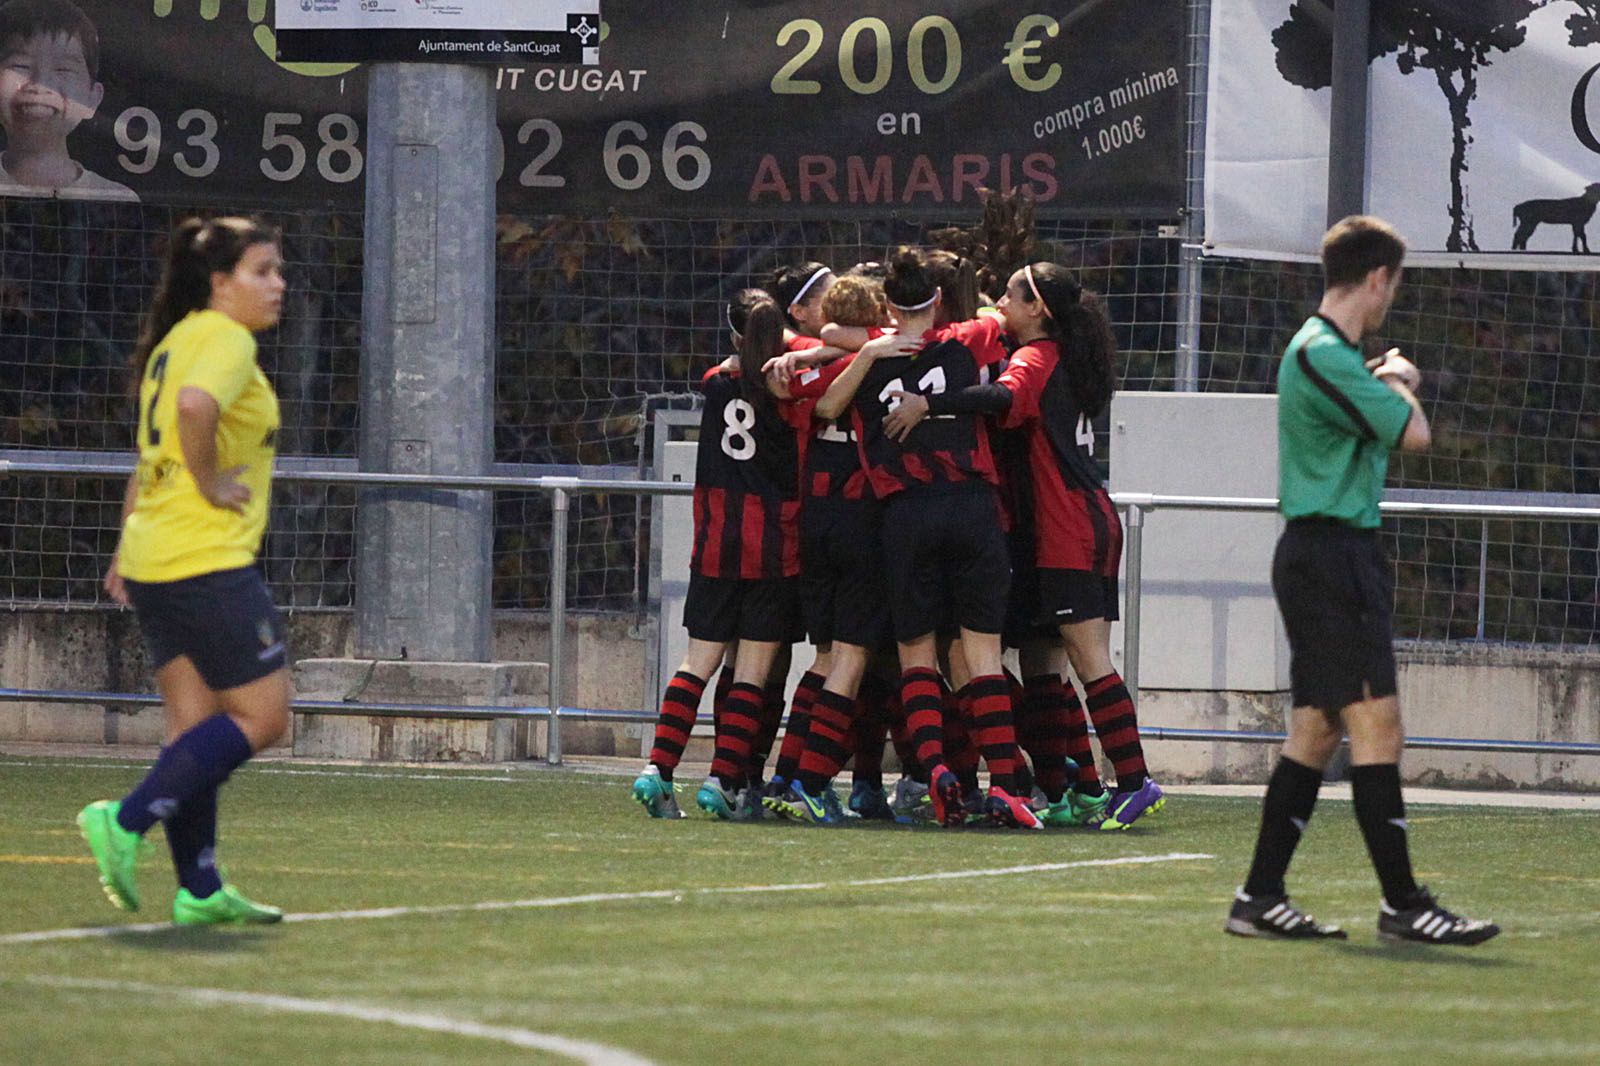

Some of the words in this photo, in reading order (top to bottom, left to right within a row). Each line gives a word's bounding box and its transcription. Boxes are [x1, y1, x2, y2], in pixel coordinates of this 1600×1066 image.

[418, 40, 484, 53] Ajuntament
[487, 41, 501, 52] de
[503, 41, 561, 56] SantCugat
[770, 15, 962, 95] 200
[1001, 14, 1063, 92] €
[534, 68, 648, 92] CUGAT
[1033, 96, 1105, 139] compra
[1109, 66, 1179, 109] mínima
[876, 110, 921, 136] en
[1082, 115, 1146, 160] 1.000€
[113, 106, 220, 177] 93
[260, 112, 364, 183] 58
[603, 120, 711, 191] 66
[748, 152, 1060, 202] ARMARIS
[720, 398, 757, 461] 8
[1075, 411, 1095, 457] 4
